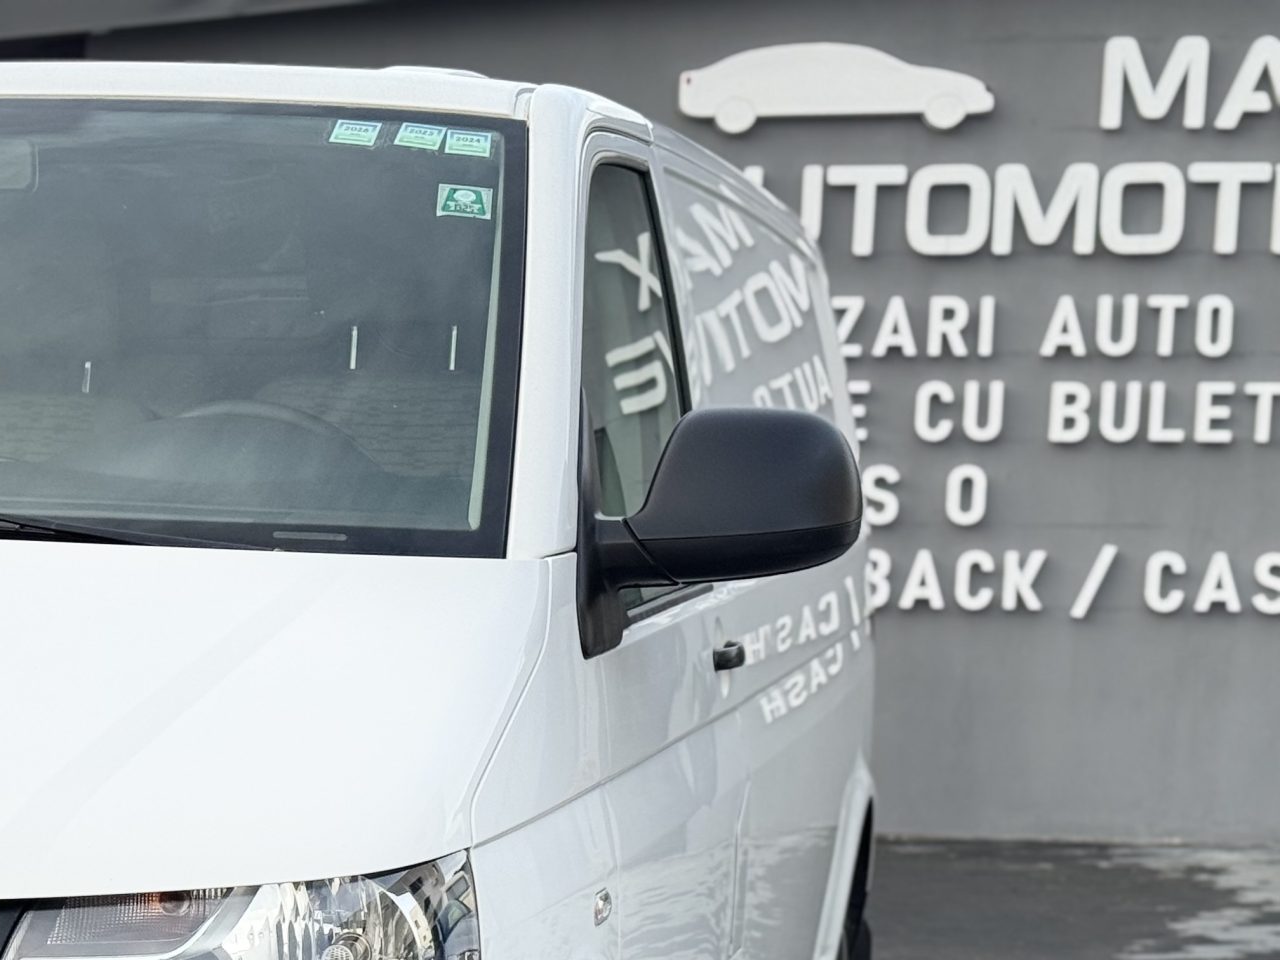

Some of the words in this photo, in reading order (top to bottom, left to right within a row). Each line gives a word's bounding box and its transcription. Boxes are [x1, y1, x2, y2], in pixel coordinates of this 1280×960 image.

[1099, 35, 1280, 130] MA
[831, 294, 996, 358] ZARI
[1039, 294, 1235, 358] AUTO
[915, 380, 1005, 442] CU
[1048, 380, 1280, 443] BULET
[866, 548, 1047, 612] BACK
[1070, 543, 1119, 619] /
[1144, 550, 1280, 614] CAS
